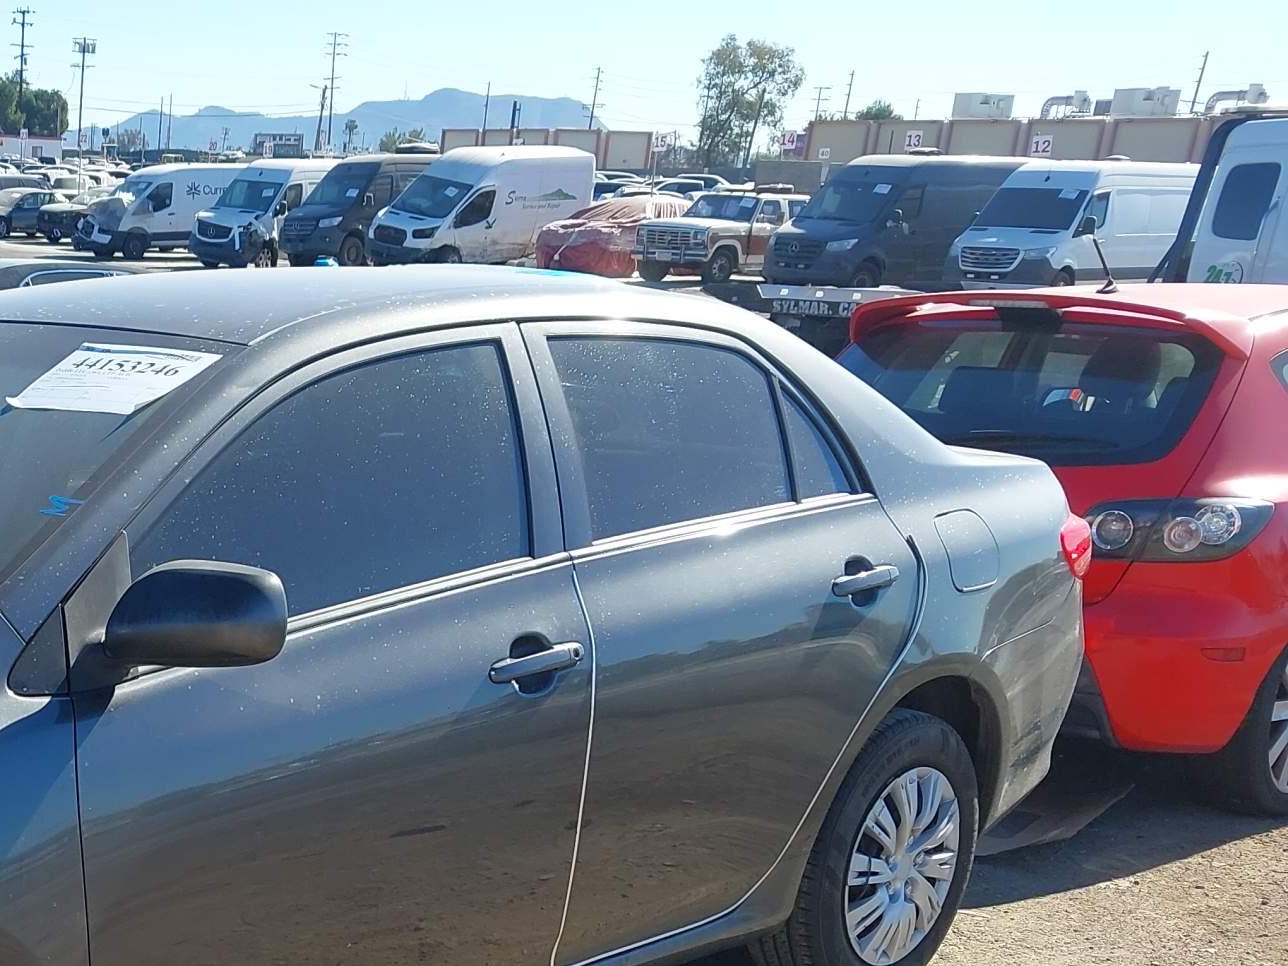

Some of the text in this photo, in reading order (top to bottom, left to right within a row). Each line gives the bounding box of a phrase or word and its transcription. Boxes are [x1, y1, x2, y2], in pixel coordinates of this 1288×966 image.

[654, 135, 666, 148] 15
[780, 132, 795, 146] 14
[906, 134, 922, 147] 13
[1032, 139, 1051, 154] 12
[71, 356, 187, 378] 44153246
